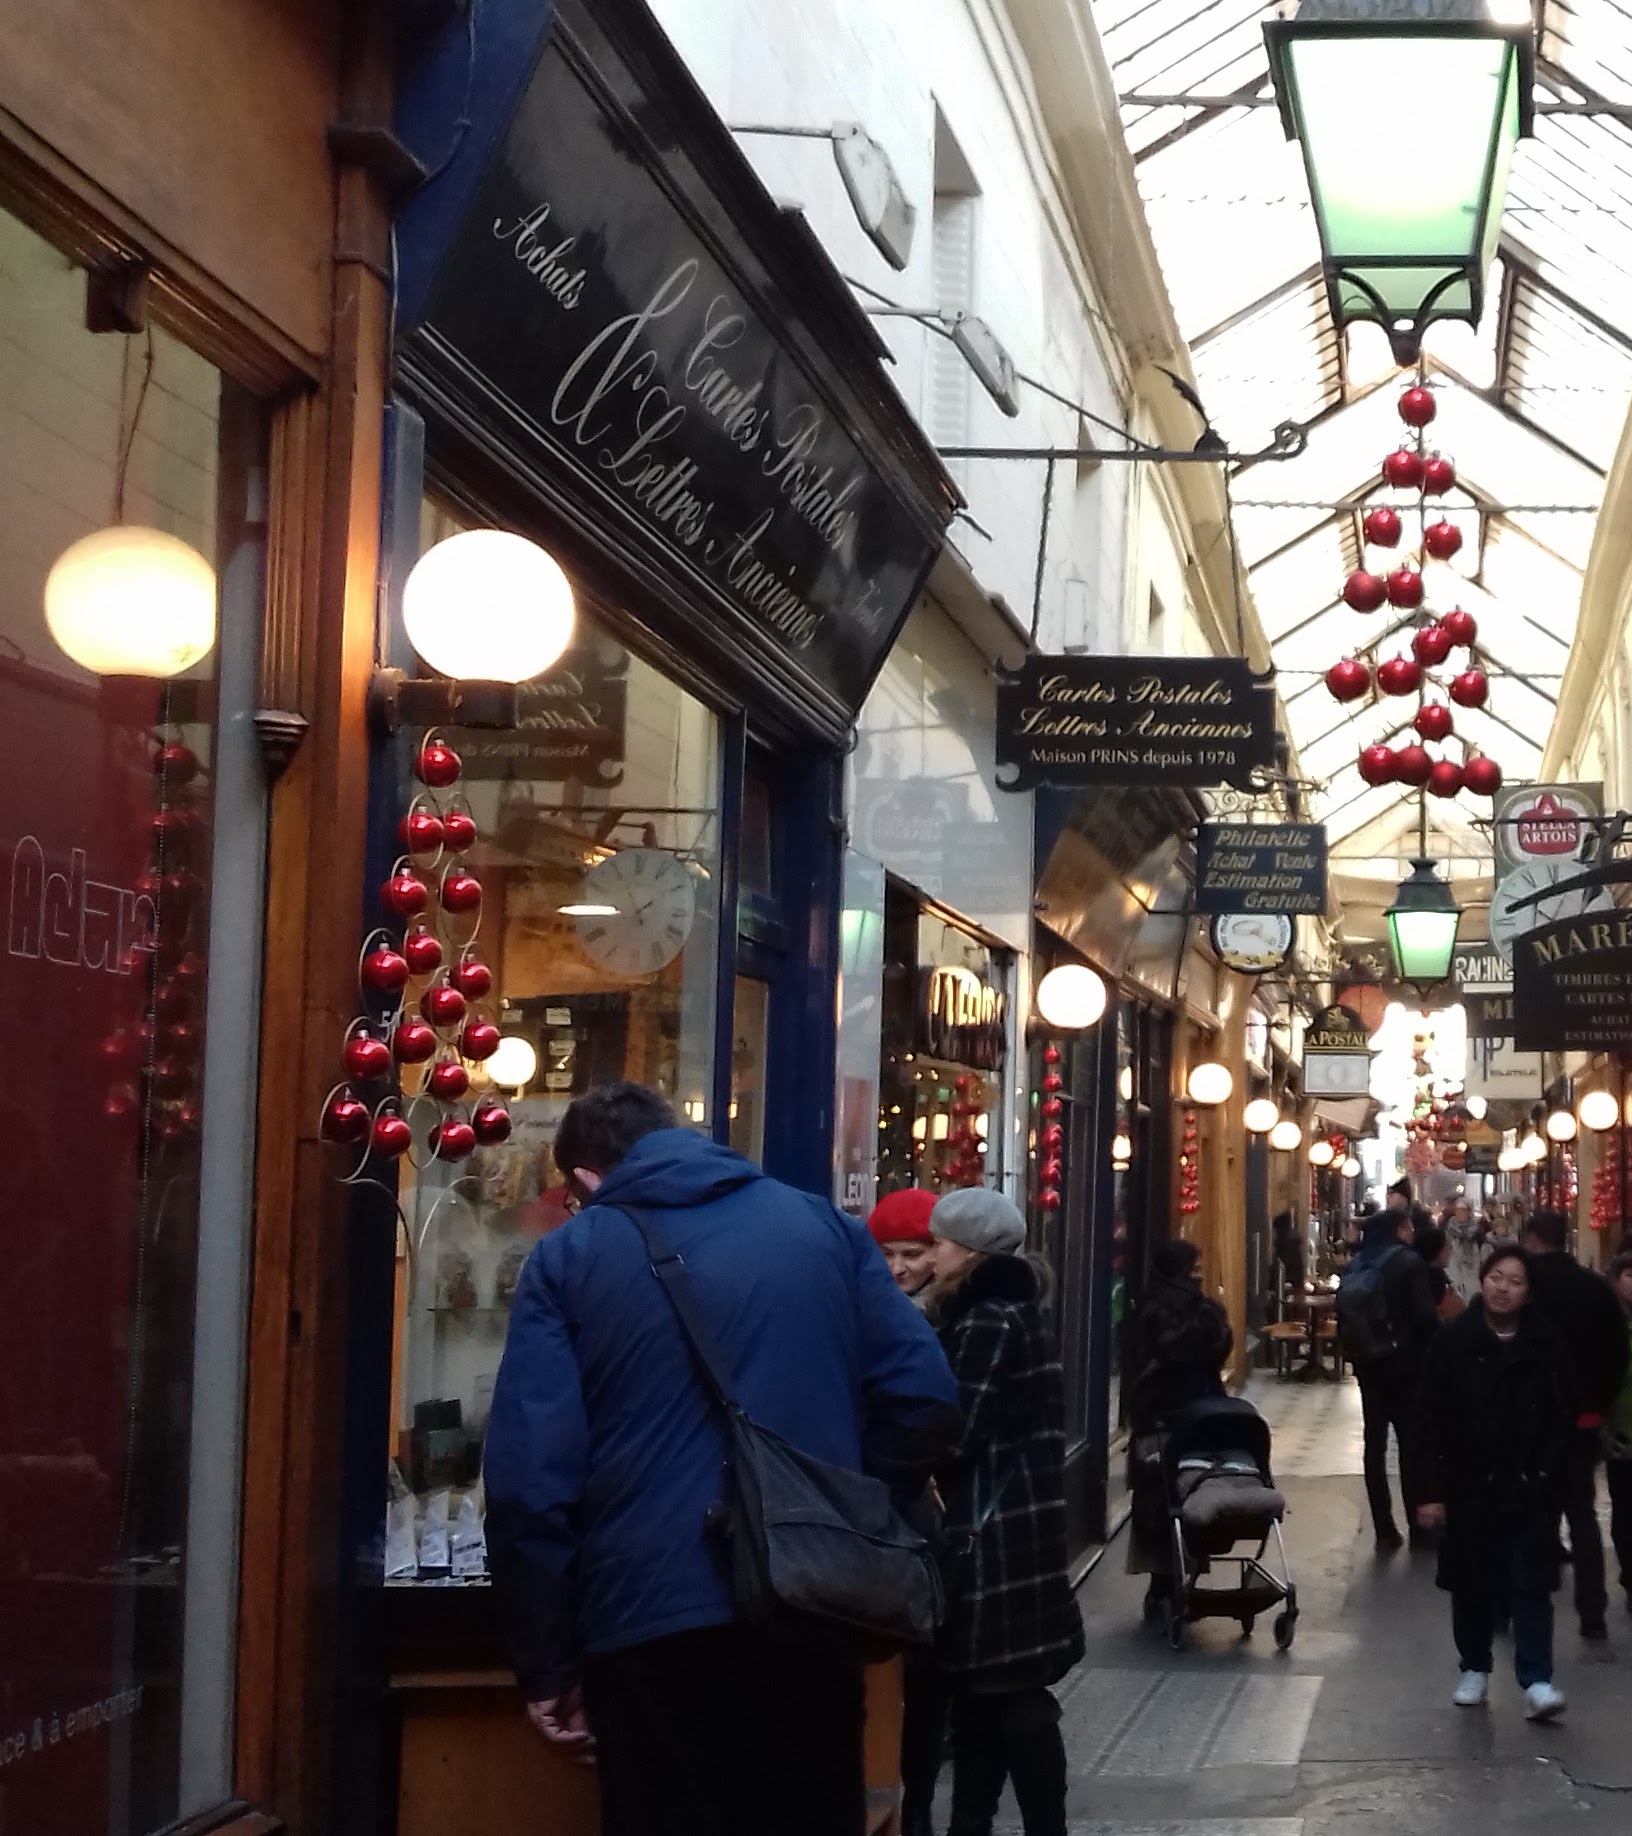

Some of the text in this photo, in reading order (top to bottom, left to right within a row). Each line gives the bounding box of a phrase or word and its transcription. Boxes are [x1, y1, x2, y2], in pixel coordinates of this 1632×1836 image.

[492, 202, 587, 310] Achats
[684, 295, 865, 551] Cartes Postales
[600, 386, 714, 546] Lettres
[1038, 673, 1234, 706] Cartes Postales
[1014, 706, 1255, 739] Lettres Anciennes
[1030, 748, 1237, 768] Maison PRINS depuis 1978
[1522, 830, 1577, 844] ARTOIS
[1207, 851, 1257, 869] Achat
[1202, 871, 1303, 889] Estimation
[1244, 890, 1321, 909] Gratuite
[1554, 972, 1622, 986] TIMBRES
[1565, 991, 1626, 1005] CARTES
